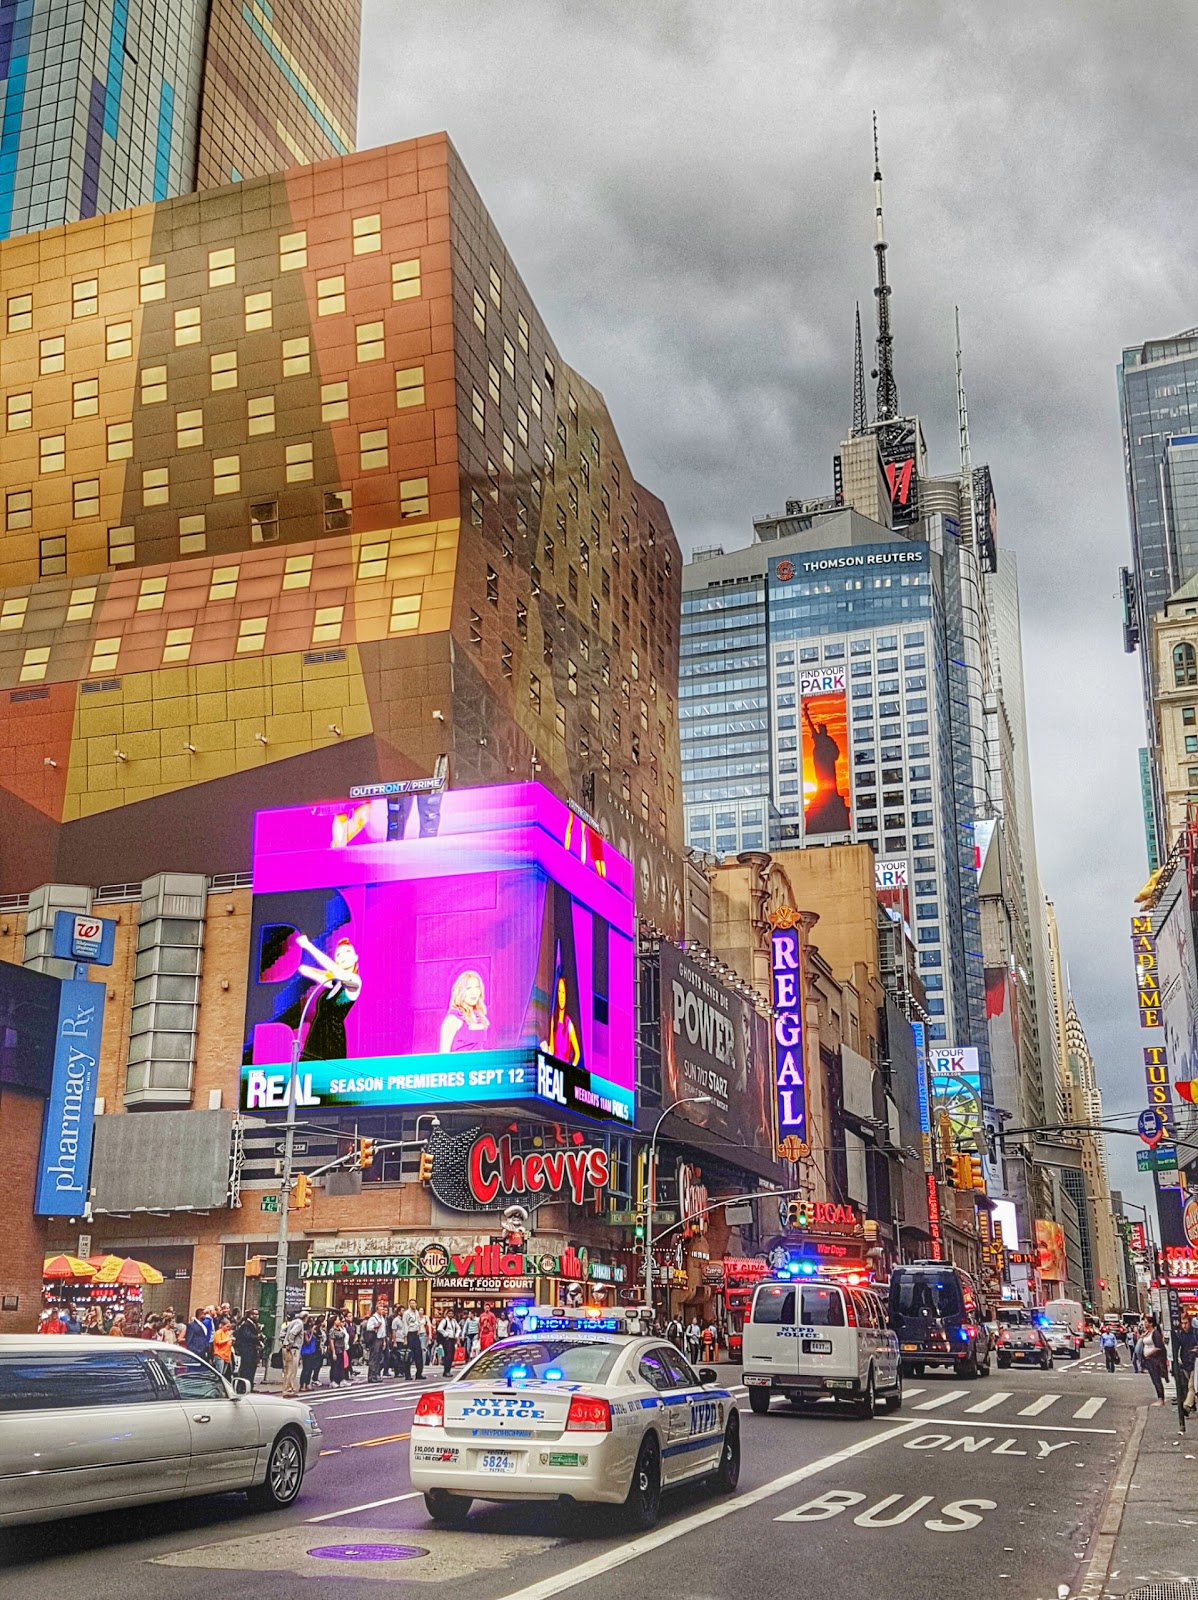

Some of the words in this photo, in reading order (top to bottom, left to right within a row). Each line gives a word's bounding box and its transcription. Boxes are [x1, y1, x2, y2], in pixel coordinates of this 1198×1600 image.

[803, 557, 865, 572] THOMSON
[867, 551, 922, 565] REUTERS
[800, 671, 820, 679] FIND
[821, 666, 844, 676] YOUR
[801, 675, 844, 693] PARK
[352, 783, 406, 796] OUTFRONT
[412, 779, 440, 789] PRIME
[881, 861, 906, 871] YOUR
[875, 870, 907, 885] ARK
[1132, 916, 1161, 1027] MADAME
[679, 962, 702, 990] GHOSTS
[702, 979, 720, 1004] NEVER
[720, 993, 729, 1011] DIE
[672, 979, 736, 1070] POWER
[771, 937, 804, 1126] REGAL
[936, 1049, 964, 1057] YOUR
[329, 1077, 384, 1094] SEASON
[387, 1071, 465, 1091] PREMIERES
[469, 1069, 505, 1086] SEPT
[508, 1068, 525, 1084] 12
[538, 1060, 568, 1106] REAL
[684, 1059, 697, 1081] SUN
[708, 1070, 729, 1099] STARZ
[246, 1073, 321, 1109] REAL
[574, 1085, 600, 1108] WEEKDAYS
[47, 1045, 96, 1194] pharmacy
[1137, 1151, 1149, 1160] M42
[469, 1132, 610, 1205] Chevys
[817, 1243, 831, 1254] War
[830, 1244, 847, 1257] Dogs
[300, 1260, 335, 1277] PIZZA
[353, 1258, 399, 1276] SALADS
[420, 1254, 447, 1266] villa
[450, 1244, 523, 1276] villa
[741, 1263, 765, 1271] GUYS
[436, 1279, 475, 1288] MARKET
[476, 1279, 501, 1288] FOOD
[503, 1279, 534, 1289] COURT
[577, 1320, 617, 1329] MOVE
[776, 1331, 821, 1339] POLICE
[472, 1398, 535, 1408] NYPD
[462, 1407, 545, 1419] POLICE
[690, 1402, 717, 1435] NYPD
[414, 1445, 435, 1454] $10,000
[436, 1447, 460, 1455] REWARD
[902, 1434, 1074, 1458] ONLY
[482, 1456, 508, 1468] 5824
[772, 1489, 998, 1532] BUS
